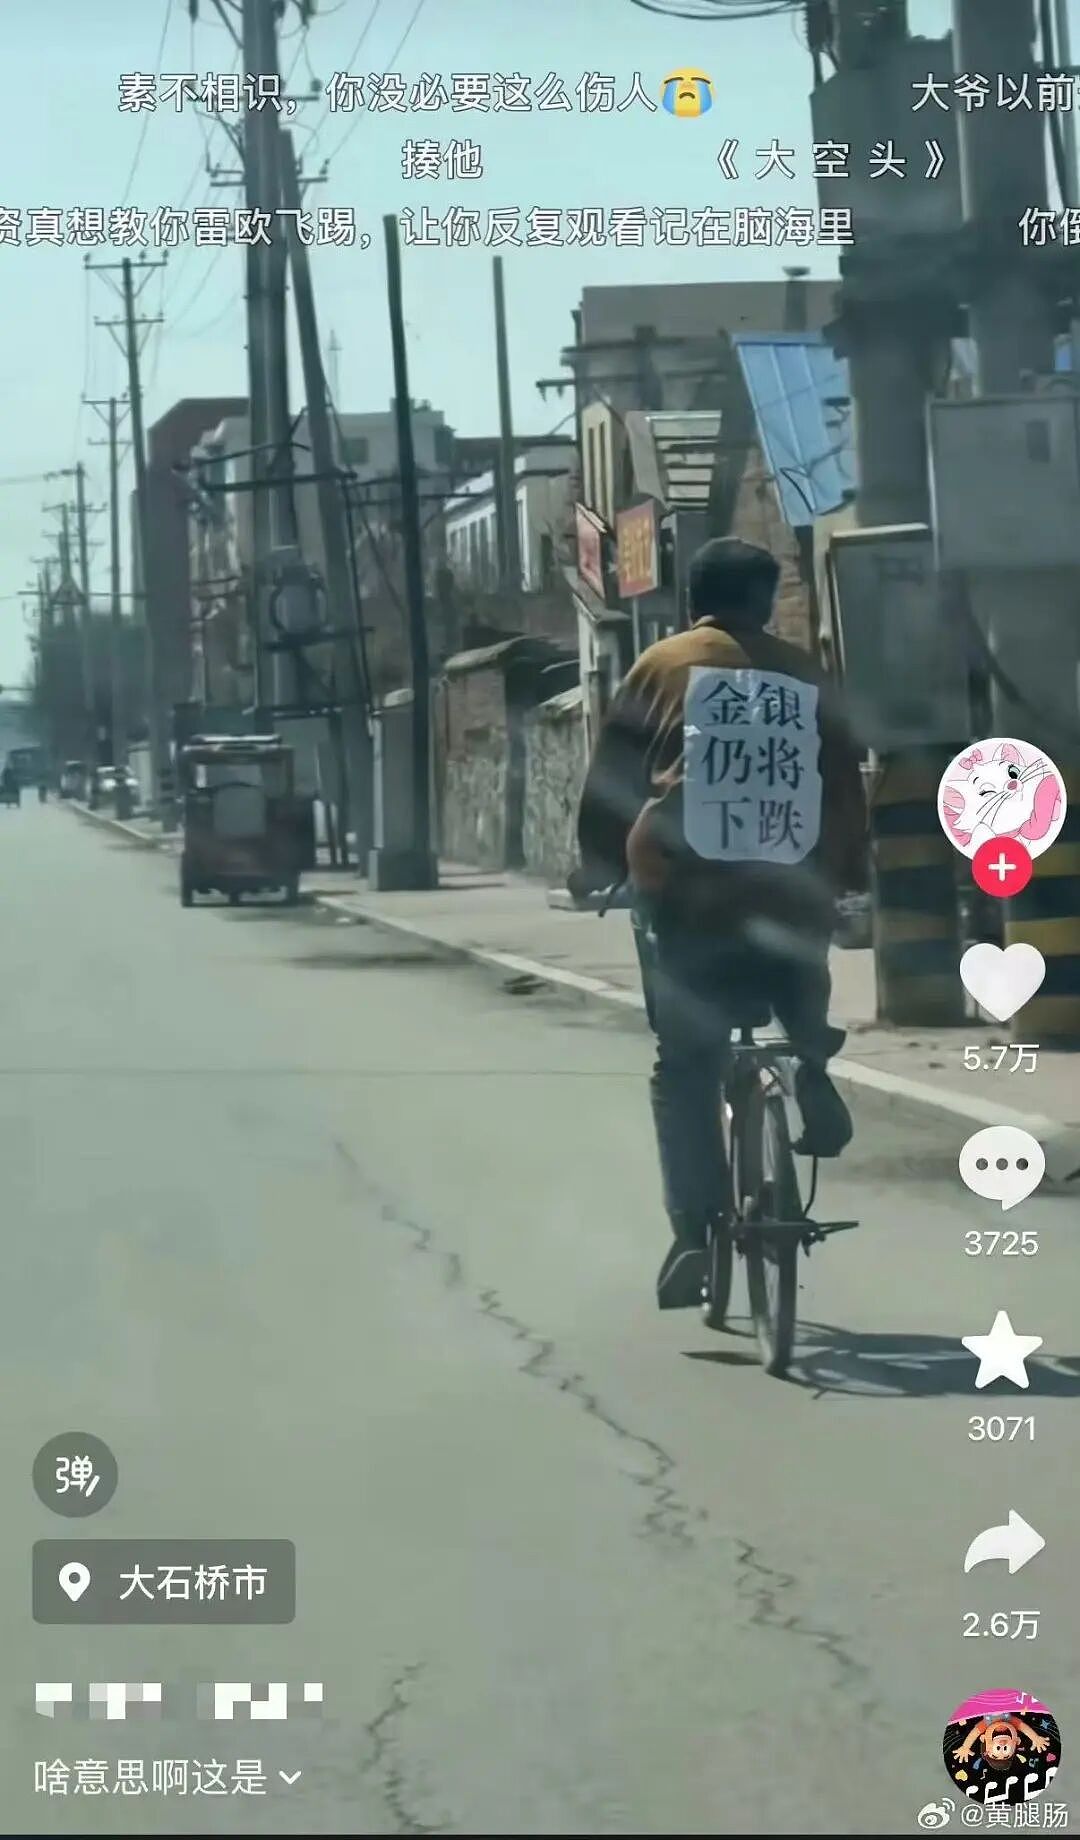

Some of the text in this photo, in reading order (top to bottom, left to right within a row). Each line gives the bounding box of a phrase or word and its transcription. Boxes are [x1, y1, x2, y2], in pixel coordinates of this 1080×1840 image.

[702, 680, 804, 730] 金银
[702, 736, 804, 790] 仍将
[702, 797, 803, 849] 下跌
